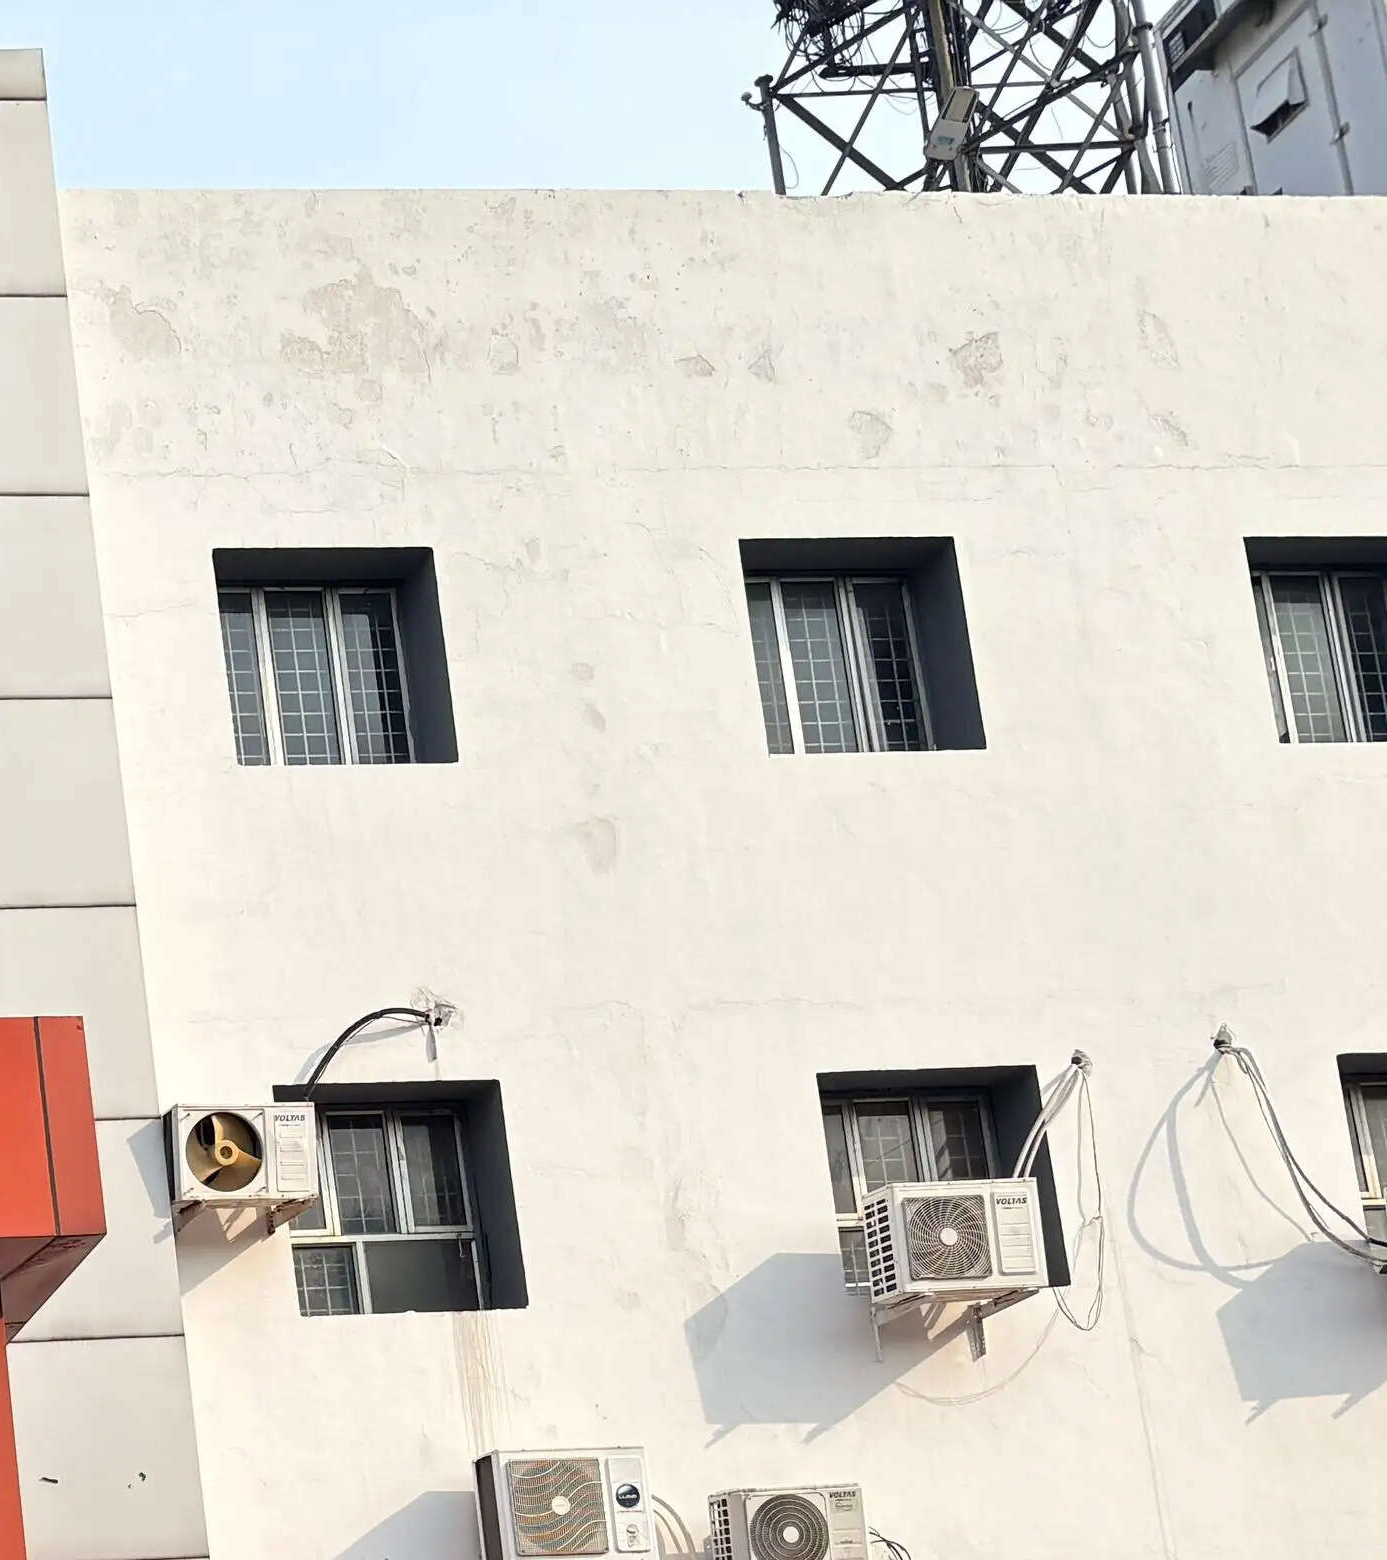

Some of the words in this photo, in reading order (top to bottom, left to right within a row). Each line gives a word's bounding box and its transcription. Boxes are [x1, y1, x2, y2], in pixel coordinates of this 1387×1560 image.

[274, 1114, 306, 1122] VOLTAS
[995, 1196, 1028, 1206] VOLTAS
[829, 1490, 857, 1499] VOLTAS
